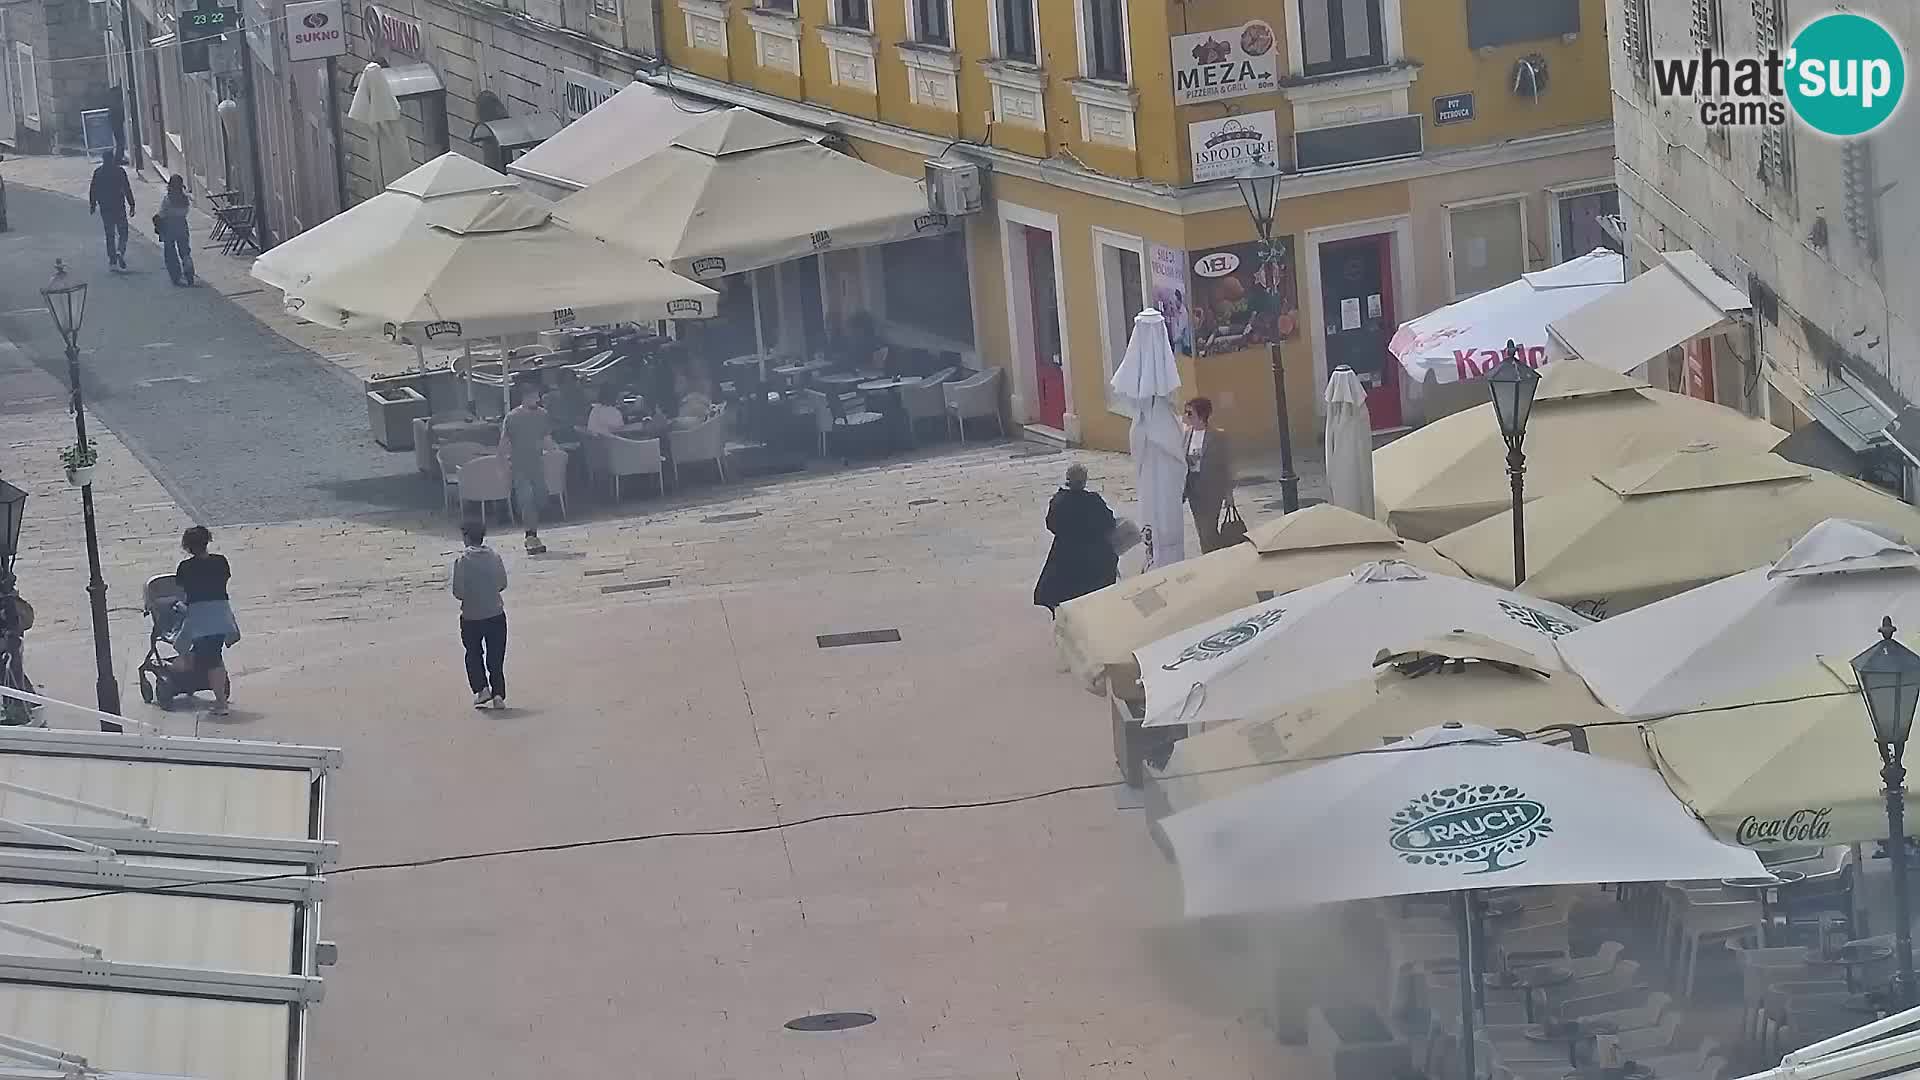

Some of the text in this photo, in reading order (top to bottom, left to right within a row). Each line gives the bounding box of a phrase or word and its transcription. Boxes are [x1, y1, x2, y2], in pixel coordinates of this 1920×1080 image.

[295, 30, 340, 44] SUKNO
[382, 14, 421, 54] SUKNO
[1177, 60, 1257, 90] MEZA
[1186, 86, 1219, 99] PIZZERIA
[1227, 84, 1248, 94] GRILL
[1196, 145, 1241, 164] ISPOD
[1246, 140, 1275, 155] URE
[1429, 806, 1527, 841] RAUCH
[1736, 808, 1832, 846] Coca-Cola
